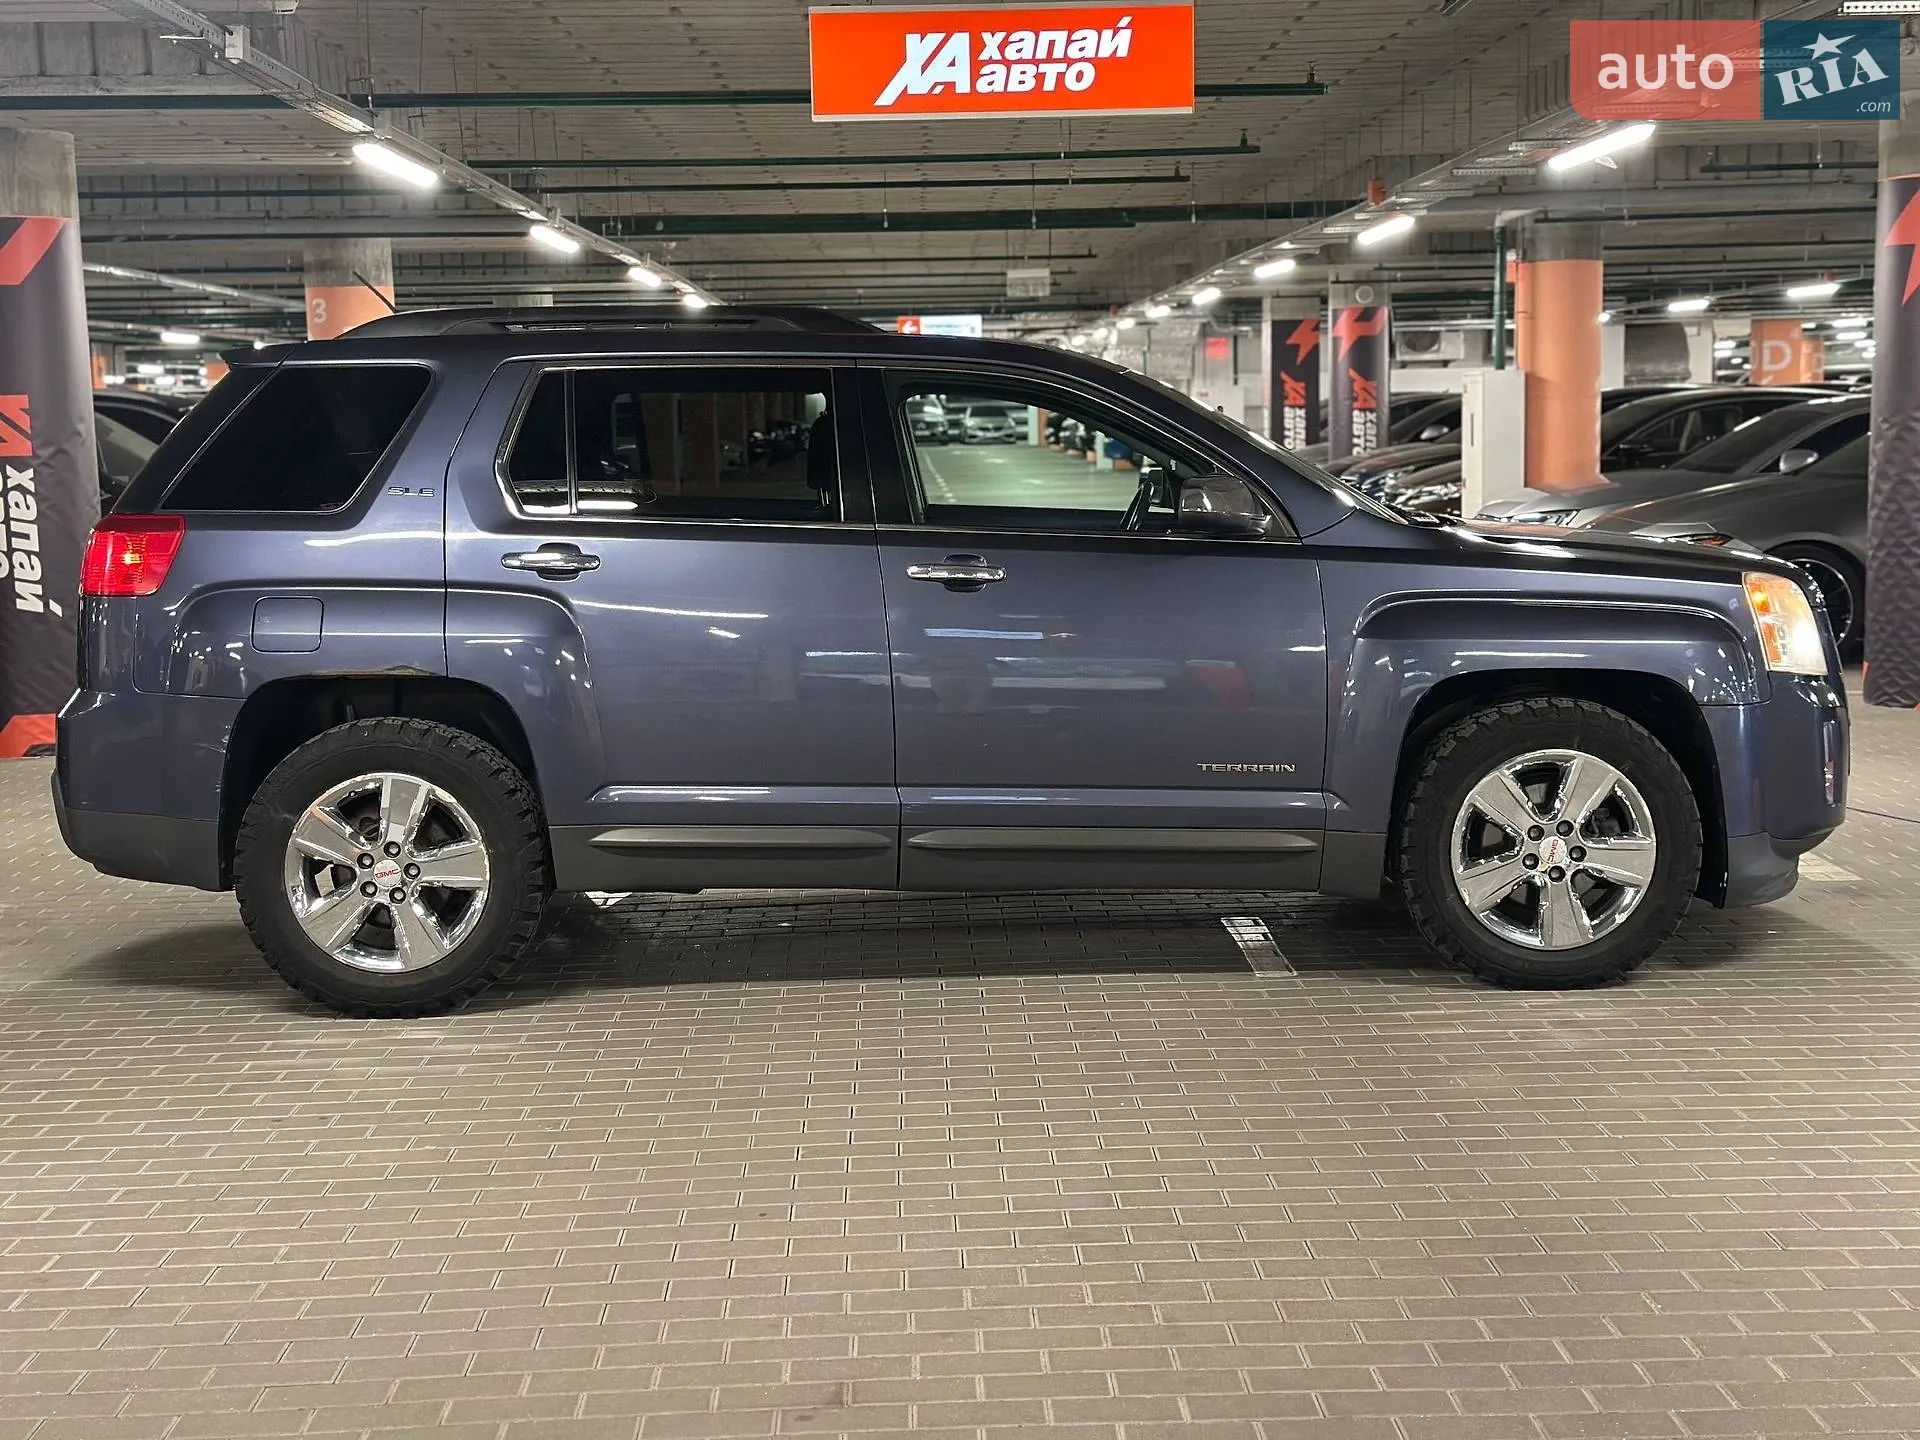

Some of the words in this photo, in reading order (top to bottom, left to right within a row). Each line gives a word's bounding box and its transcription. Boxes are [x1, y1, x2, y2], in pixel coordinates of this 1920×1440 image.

[873, 31, 971, 106] ХА
[977, 16, 1133, 61] хапай
[975, 60, 1096, 94] авто
[312, 298, 327, 323] 3
[1762, 340, 1793, 371] D
[1295, 407, 1307, 450] хапа
[1366, 410, 1377, 452] хап
[388, 486, 435, 497] SLE
[6, 464, 63, 617] хапай
[1197, 763, 1295, 773] TERRAIN
[1548, 839, 1558, 862] GMC
[375, 868, 400, 878] GMC
